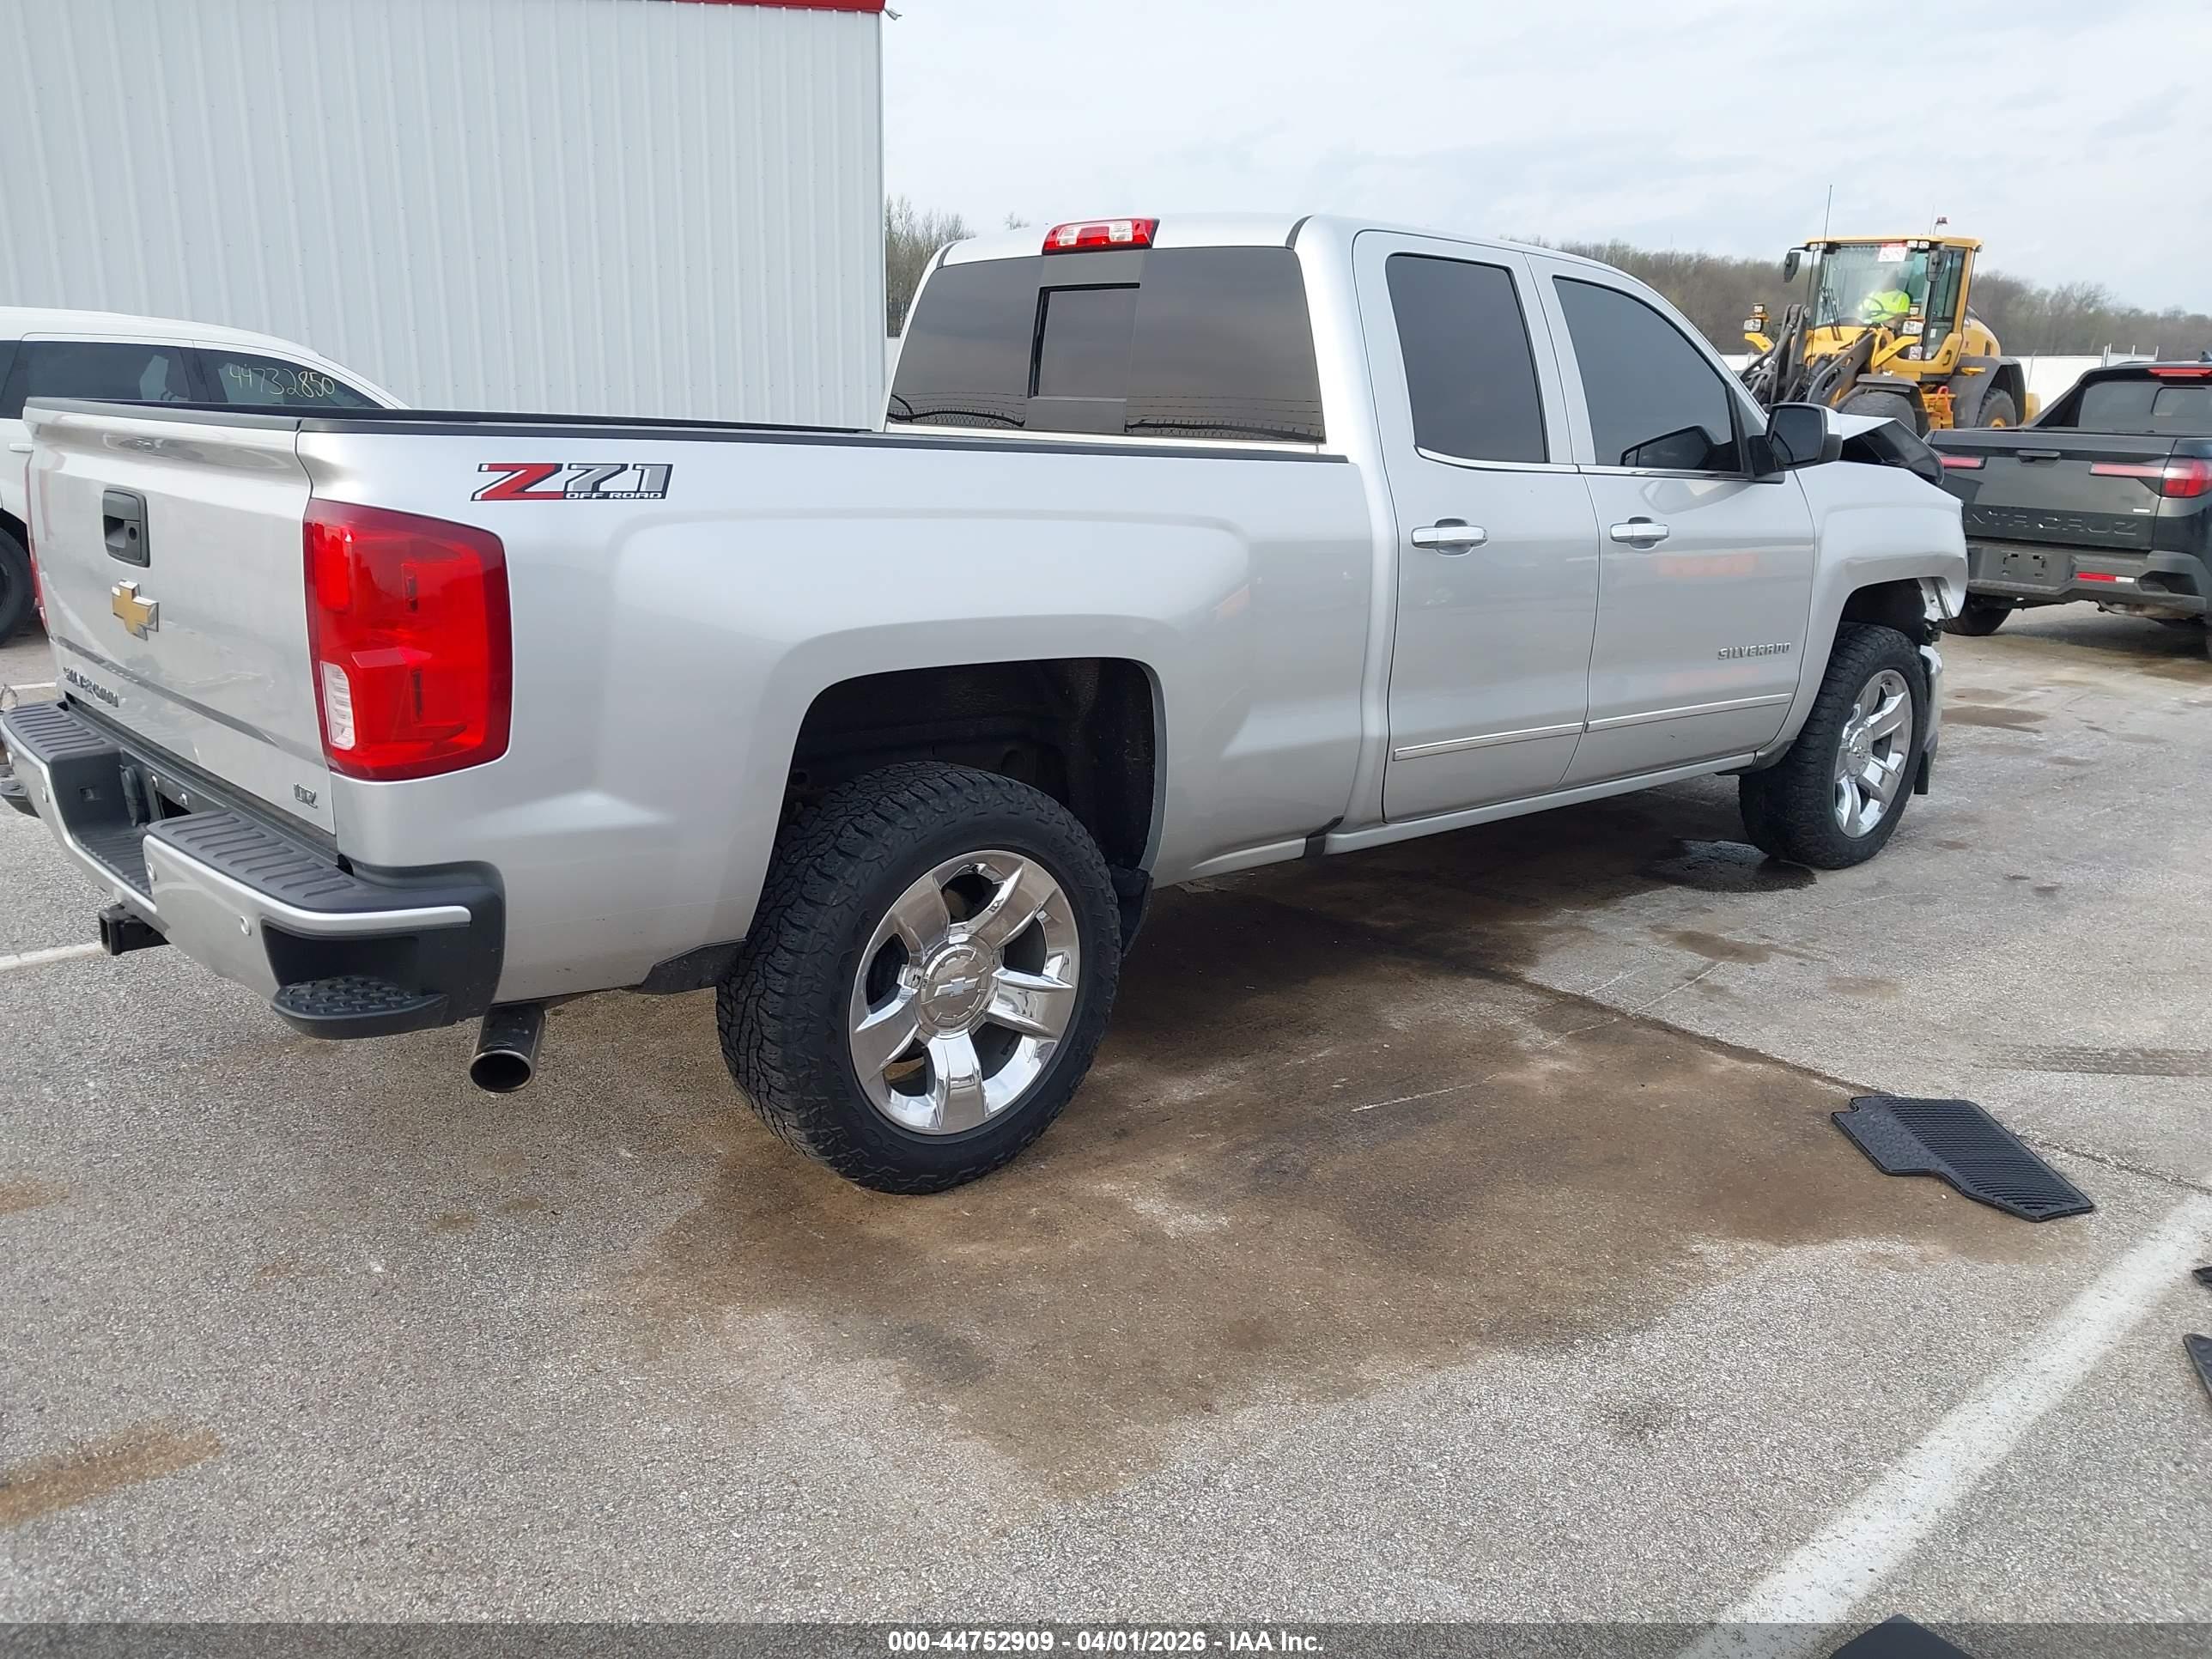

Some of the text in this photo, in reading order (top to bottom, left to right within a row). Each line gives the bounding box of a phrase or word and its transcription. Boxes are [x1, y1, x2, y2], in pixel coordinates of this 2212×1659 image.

[229, 363, 335, 398] 44732850
[470, 463, 673, 501] Z71
[565, 491, 664, 500] OFF ROAD
[1717, 641, 1791, 660] SILVERADO
